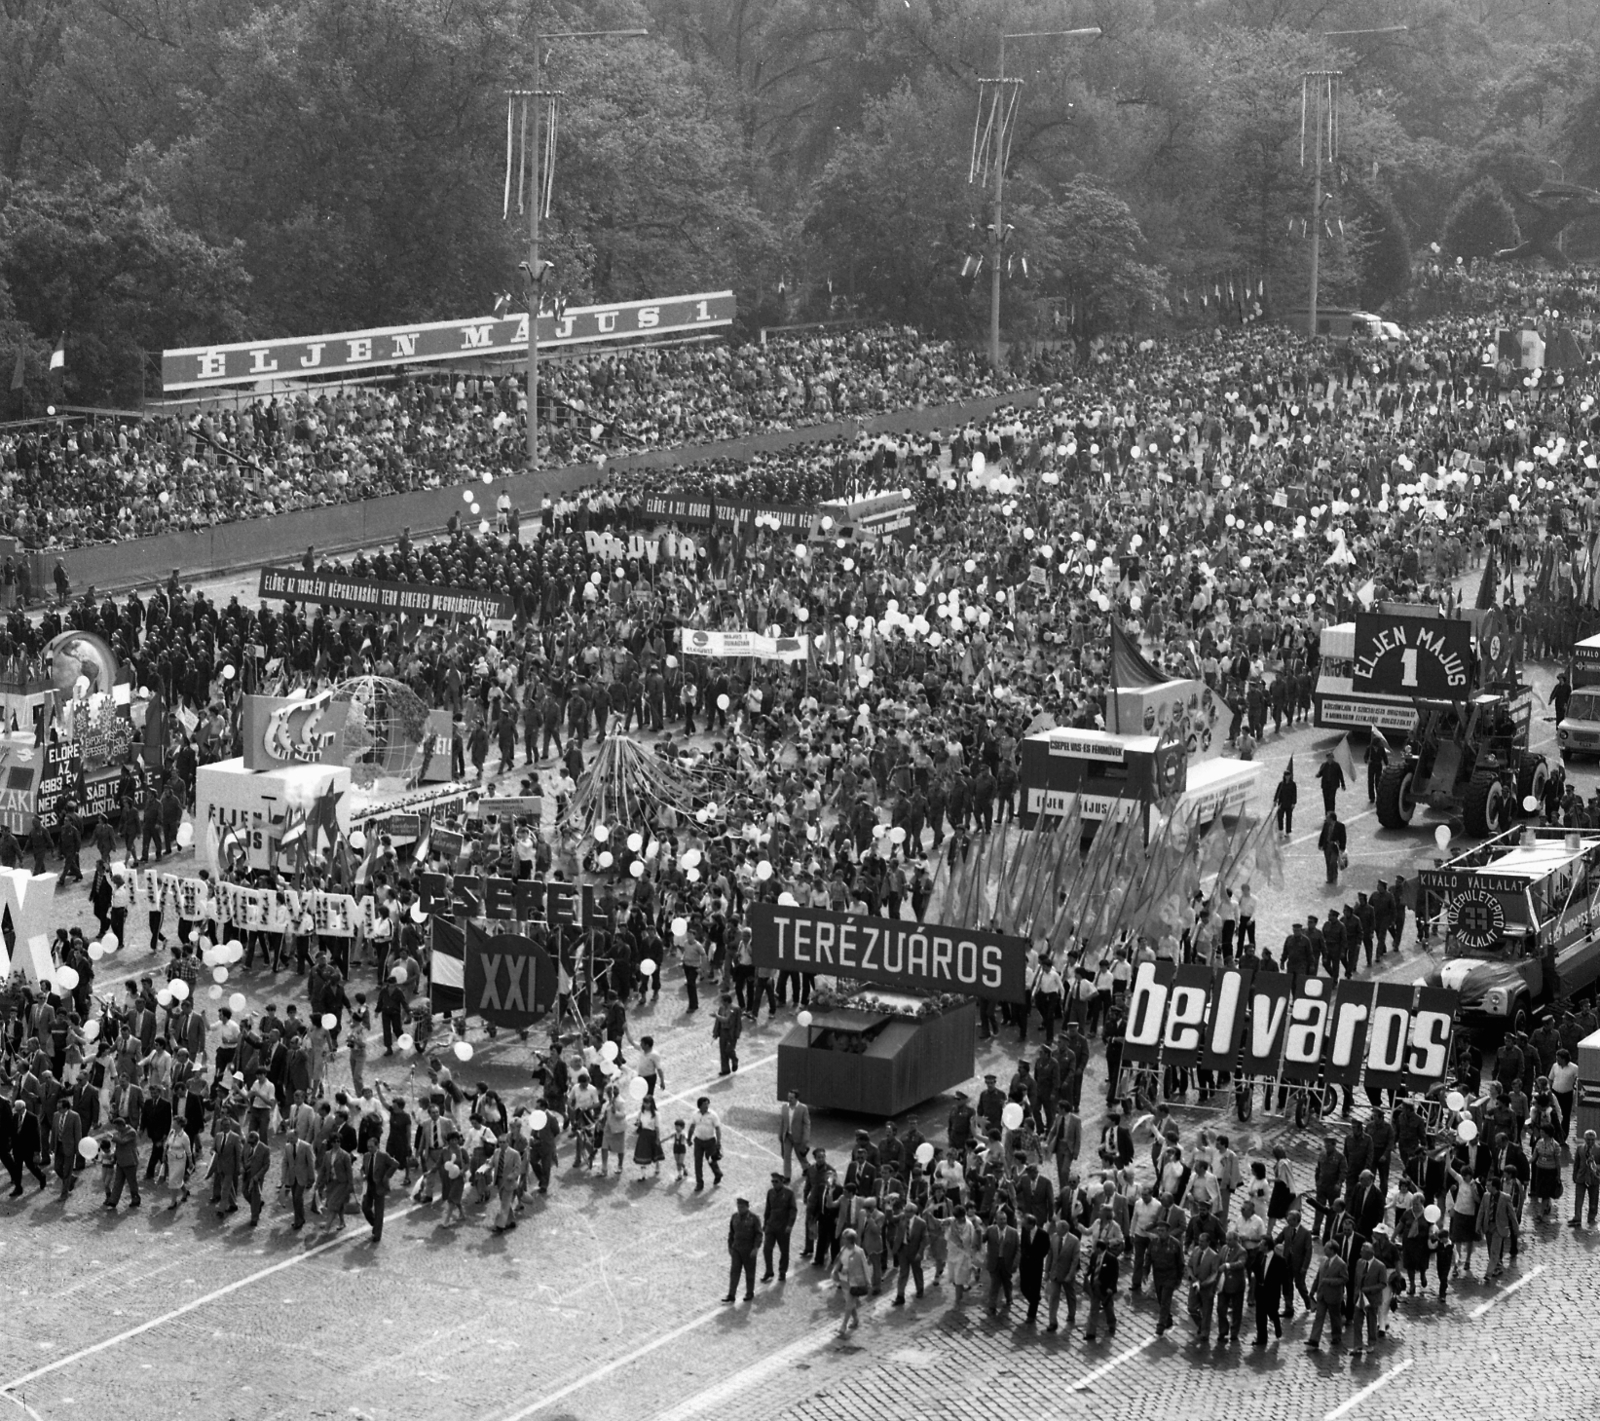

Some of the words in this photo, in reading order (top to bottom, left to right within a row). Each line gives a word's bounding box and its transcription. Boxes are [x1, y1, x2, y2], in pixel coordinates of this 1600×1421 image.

[197, 333, 420, 379] ÉLJEN
[668, 500, 673, 514] A
[584, 530, 695, 564] DANUVIA
[287, 577, 296, 593] AZ
[381, 589, 398, 606] TERV
[400, 591, 430, 609] SIKERES
[1400, 647, 1418, 687] 1
[1050, 740, 1070, 752] CSEPEL
[58, 760, 70, 776] AZ
[419, 872, 609, 926] CSEPEL
[479, 952, 545, 1014] XXI.
[1125, 961, 1454, 1078] belváros
